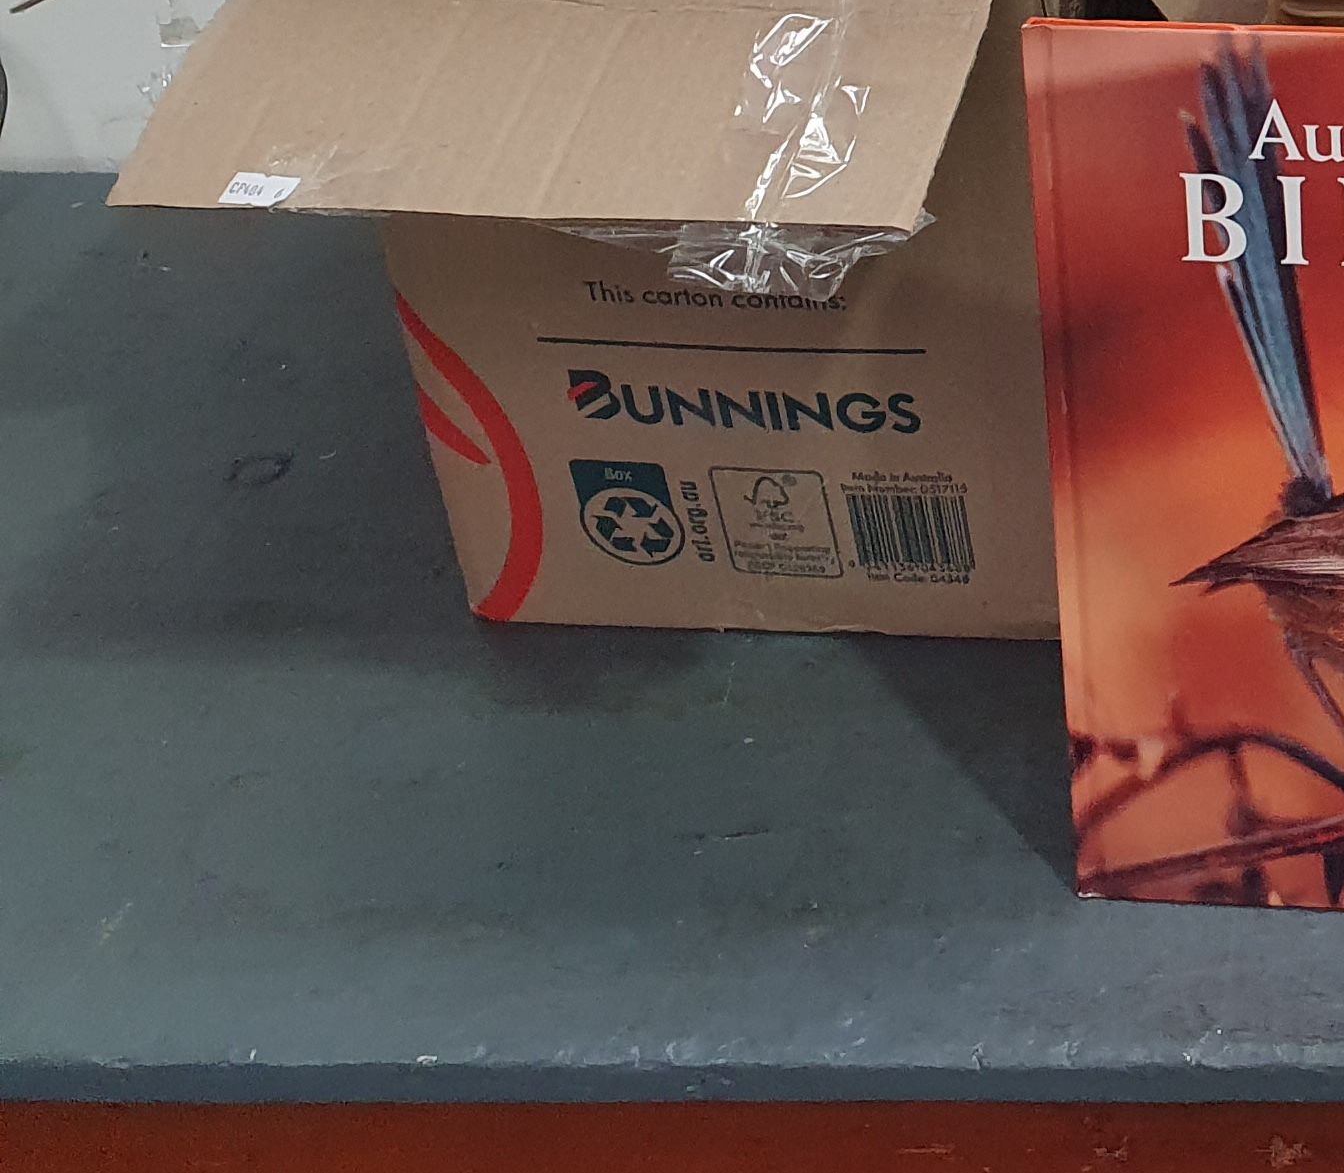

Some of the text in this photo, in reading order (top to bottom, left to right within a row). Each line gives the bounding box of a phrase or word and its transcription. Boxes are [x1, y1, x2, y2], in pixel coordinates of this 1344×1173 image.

[586, 280, 847, 311] This carton contains:
[567, 369, 922, 434] BUNNINGS
